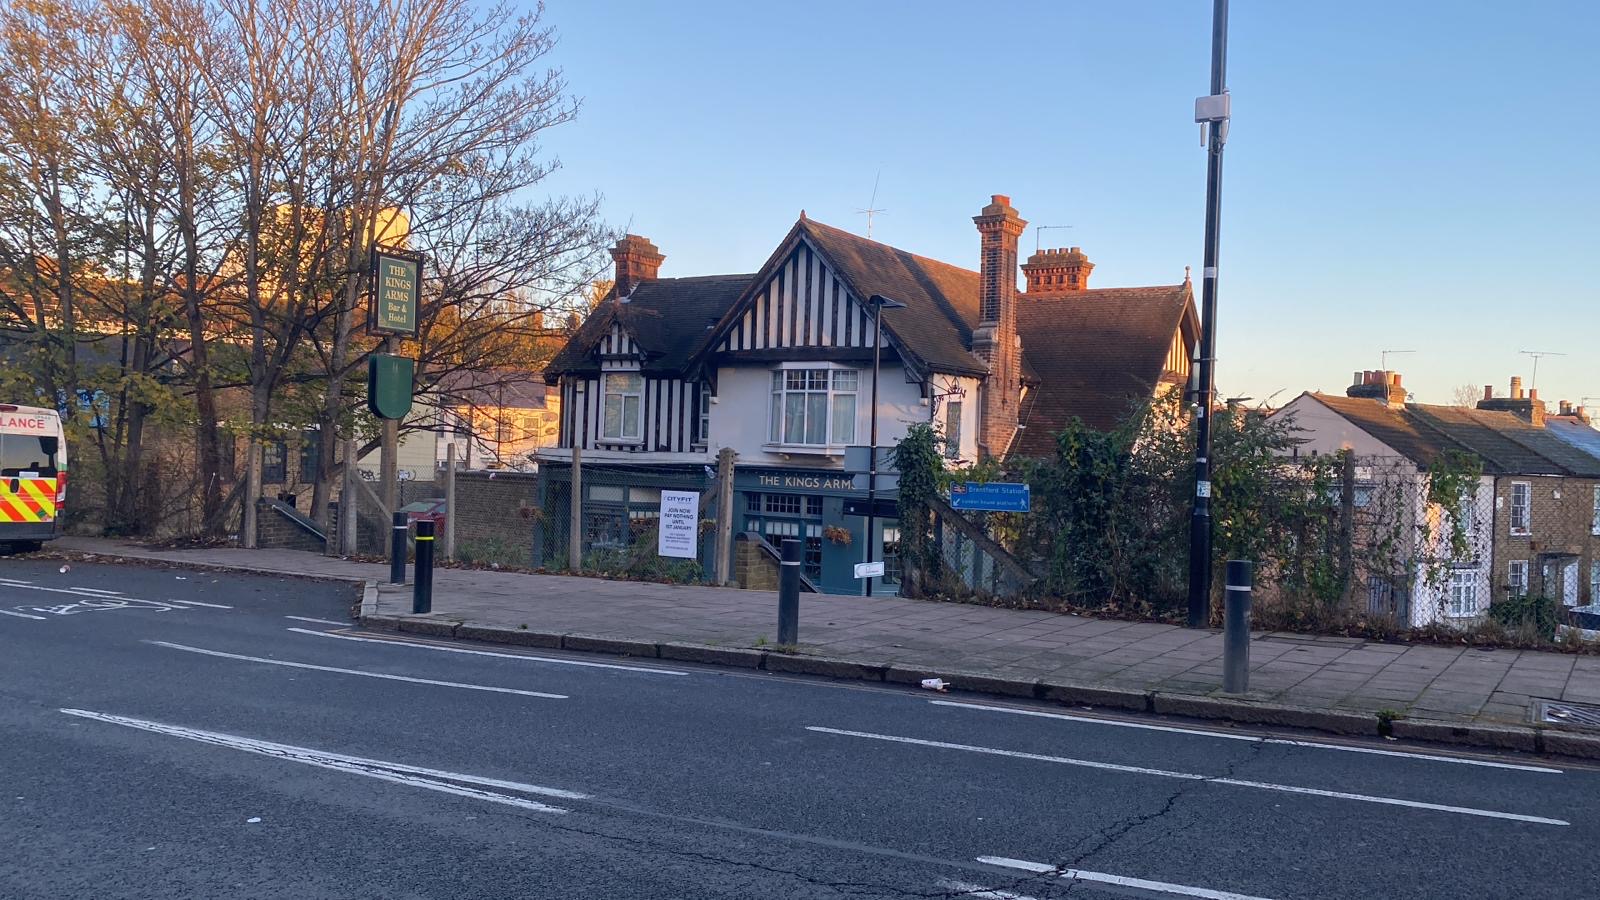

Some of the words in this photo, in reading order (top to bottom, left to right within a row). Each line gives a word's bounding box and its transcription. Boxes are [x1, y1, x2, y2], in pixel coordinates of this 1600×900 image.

[389, 265, 406, 277] THE
[385, 277, 411, 290] KINGS
[384, 290, 409, 302] ARMS
[388, 302, 400, 312] Bar
[401, 304, 407, 313] &
[388, 313, 407, 324] Hotel
[759, 475, 780, 486] THE
[785, 476, 820, 488] KINGS
